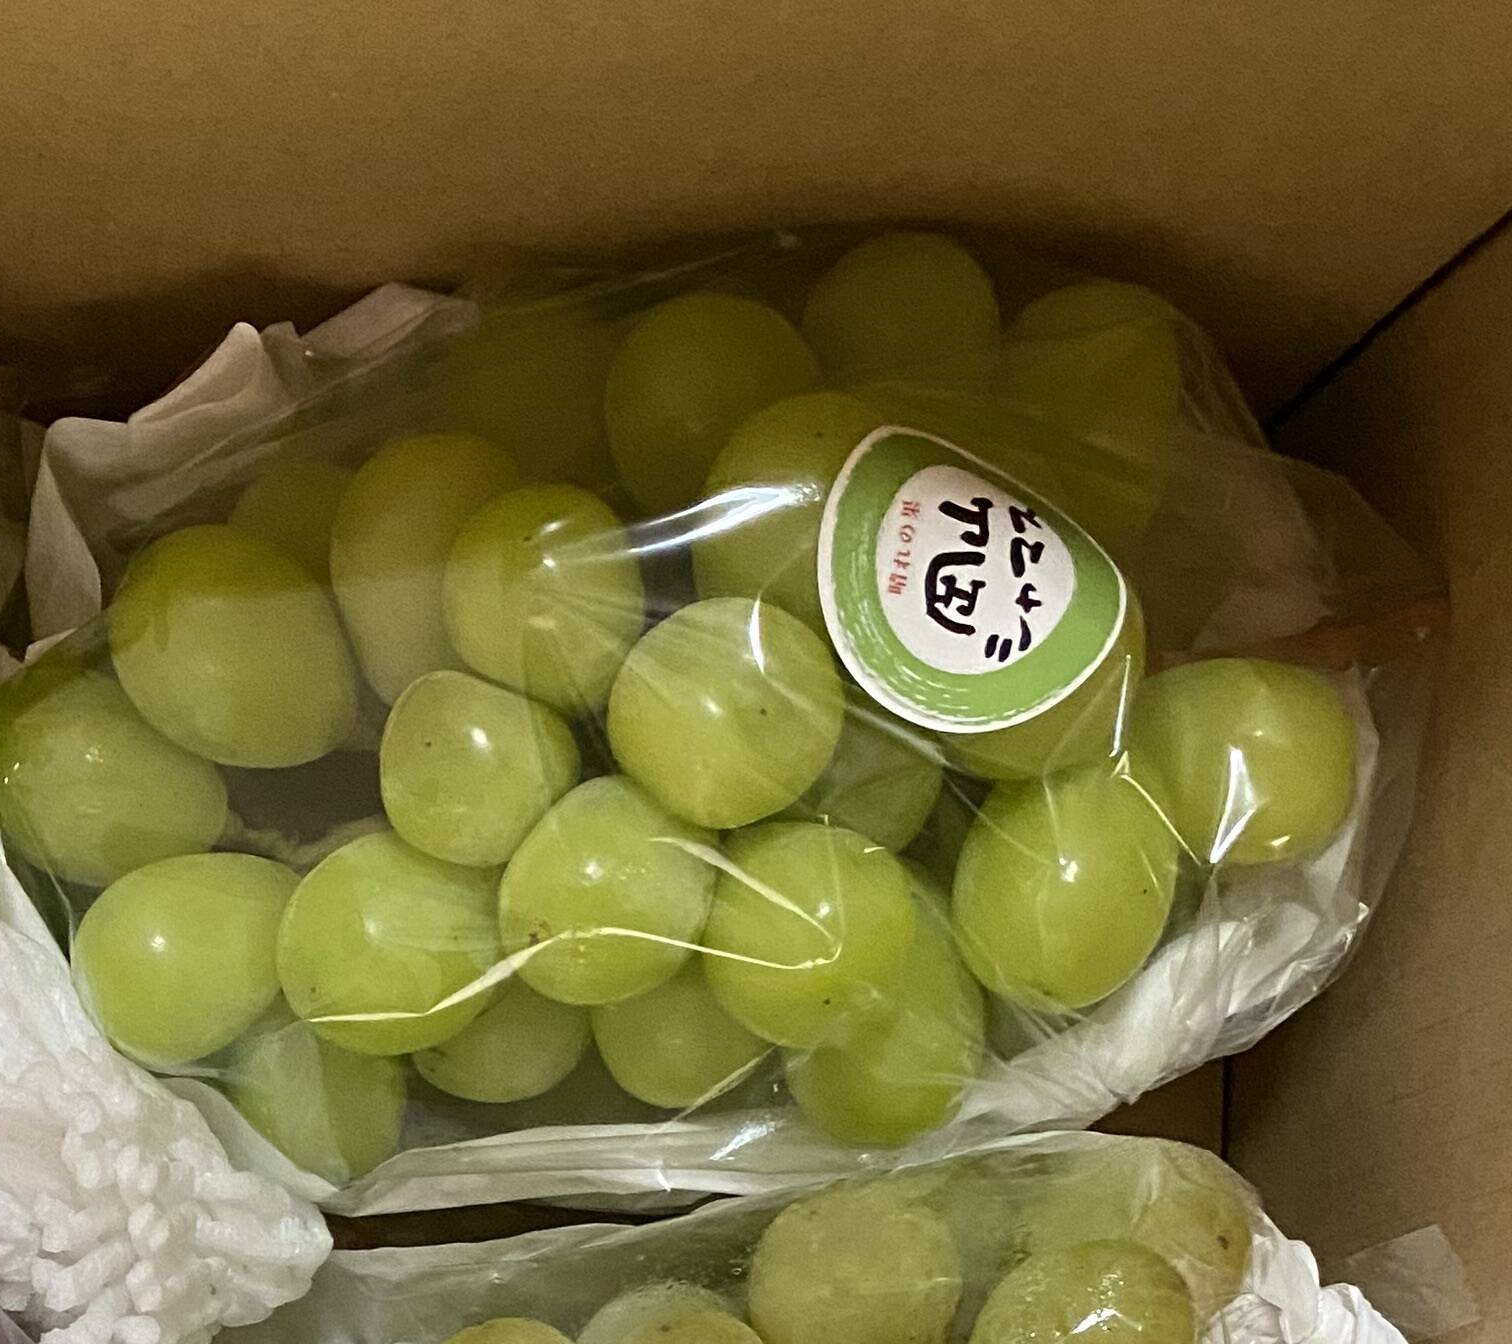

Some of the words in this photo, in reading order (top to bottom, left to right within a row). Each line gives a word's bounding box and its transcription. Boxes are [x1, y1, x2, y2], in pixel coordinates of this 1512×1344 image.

[887, 499, 921, 596] 晴れの果
[924, 496, 993, 636] 岡山
[984, 505, 1045, 663] シャマス
